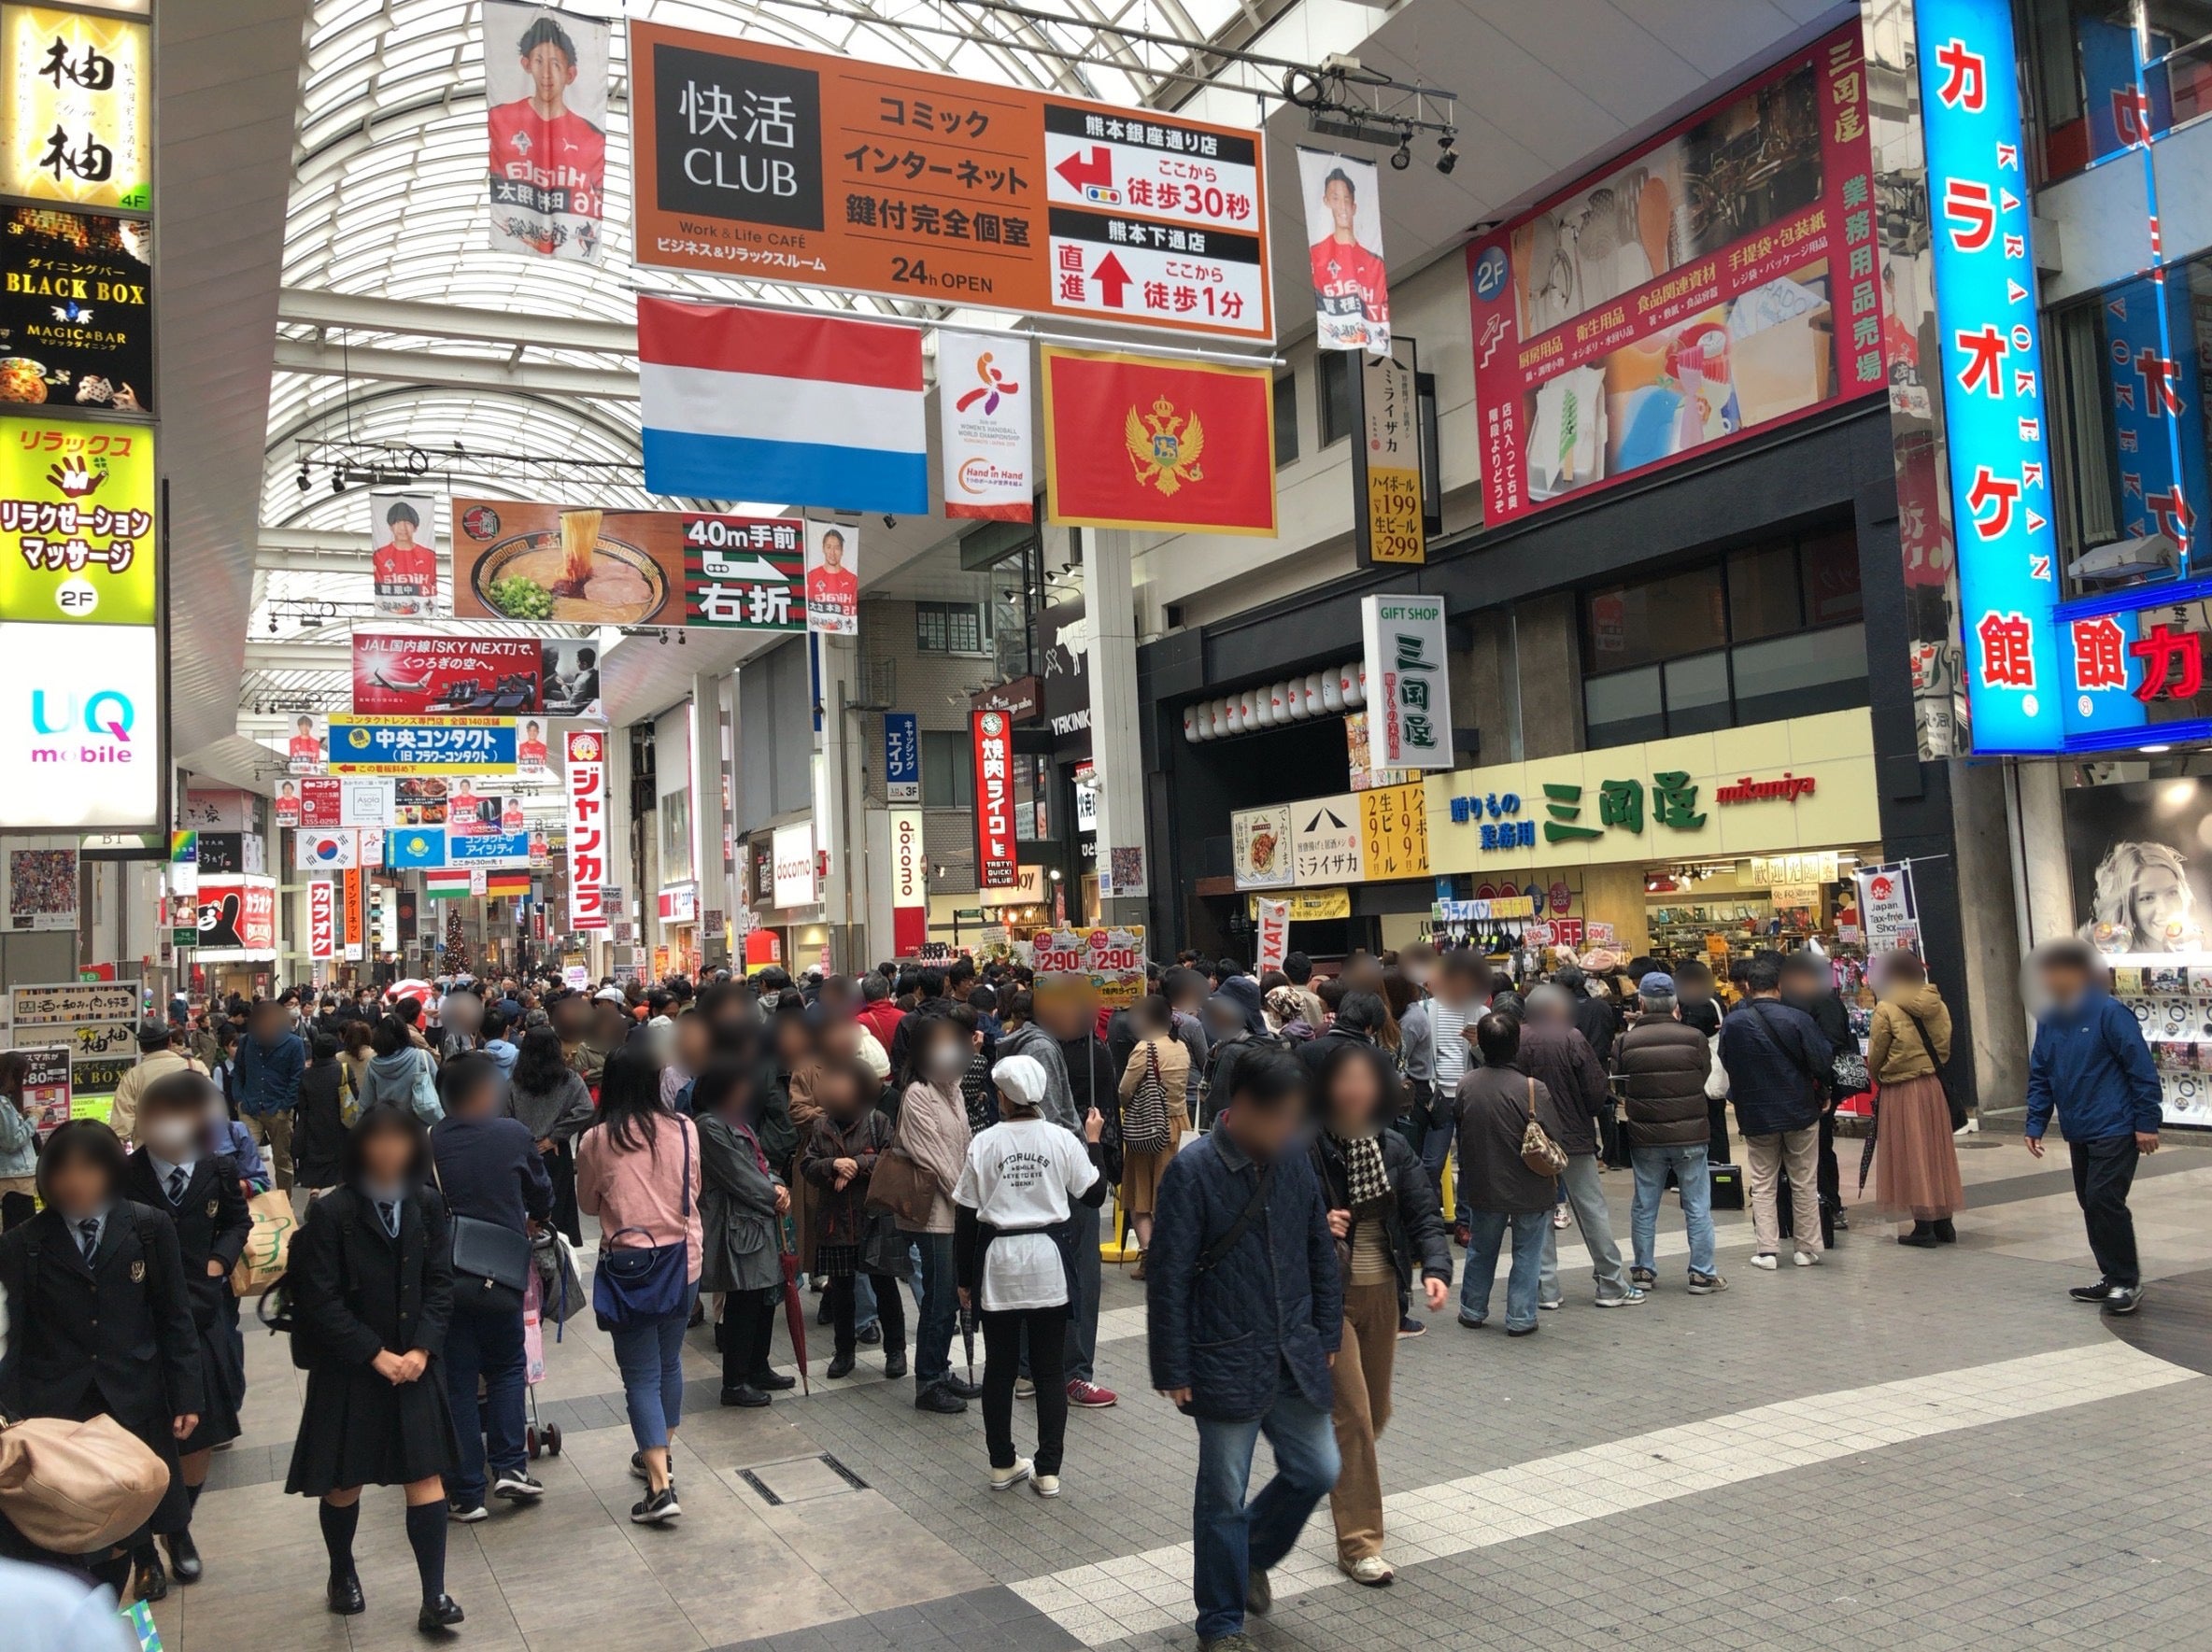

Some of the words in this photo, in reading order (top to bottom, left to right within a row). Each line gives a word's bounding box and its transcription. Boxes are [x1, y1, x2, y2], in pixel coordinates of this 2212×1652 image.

[678, 80, 796, 149] 快活
[880, 96, 990, 138] コミック
[1085, 114, 1218, 157] 熊本銀座通り店
[684, 148, 799, 197] CLUB
[844, 144, 1028, 195] インターネット
[1158, 159, 1218, 183] ここから
[121, 194, 147, 208] 4F
[1127, 176, 1251, 220] 徒歩30秒
[7, 221, 25, 235] 3F
[679, 220, 718, 239] Work
[722, 229, 732, 239] &
[735, 233, 763, 243] Life
[768, 232, 806, 248] CAFÉ
[845, 193, 1031, 248] 鍵付完全個室
[1108, 219, 1206, 254] 熊本下通店
[28, 258, 126, 277] ダイニングバー
[657, 237, 827, 272] ビジネス&リラックスルーム
[1166, 261, 1225, 283] ここから
[7, 273, 88, 300] BLACK
[97, 285, 146, 306] BOX
[942, 273, 993, 294] OPEN
[1057, 245, 1085, 303] 直進
[1476, 258, 1506, 294] 2F
[1638, 262, 1717, 315] 食品関連資材
[1842, 174, 1883, 384] 業務用品売場
[1143, 280, 1244, 320] 徒歩1分
[1576, 306, 1625, 344] 衛生用品
[1936, 37, 2037, 690] カラオケ館
[1383, 369, 1398, 453] ミライザカ
[20, 431, 133, 457] リラックス
[966, 467, 989, 477] Hand
[990, 465, 999, 478] in
[1001, 470, 1024, 480] Hand
[1373, 472, 1415, 493] ハイボール
[0, 501, 153, 539] リラクゼーション
[688, 519, 796, 550] 40m手前
[1375, 516, 1418, 534] 生ビール
[21, 538, 134, 574] マッサージ
[61, 590, 94, 607] 2F
[698, 583, 792, 625] 右折
[1381, 607, 1405, 620] GIFT
[1409, 607, 1439, 621] SHOP
[403, 657, 494, 671] くつろぎの空へ。
[32, 689, 135, 742] UQ
[346, 716, 445, 727] コンタクトレンズ専門店
[450, 716, 501, 727] 全国140店舗
[32, 746, 133, 764] mobile
[376, 728, 497, 749] 中央コンタクト
[888, 732, 902, 776] エイワ
[904, 720, 915, 770] キャッシング
[905, 786, 917, 797] 3F
[982, 738, 1006, 835] 焼肉ライク
[1451, 793, 1520, 822] 贈りもの
[1542, 770, 1708, 843] 三国屋
[465, 843, 515, 855] アイシティ
[574, 767, 602, 912] ジャンカラ
[1380, 793, 1397, 874] 生ビール
[1480, 821, 1536, 852] 業務用
[776, 858, 811, 880] docomo
[900, 821, 915, 896] docomo
[1298, 851, 1357, 876] ミライザカ
[246, 894, 273, 914] カラオケ
[312, 887, 331, 953] カラオケ
[1871, 902, 1898, 911] Japan
[1549, 921, 1581, 947] OFF
